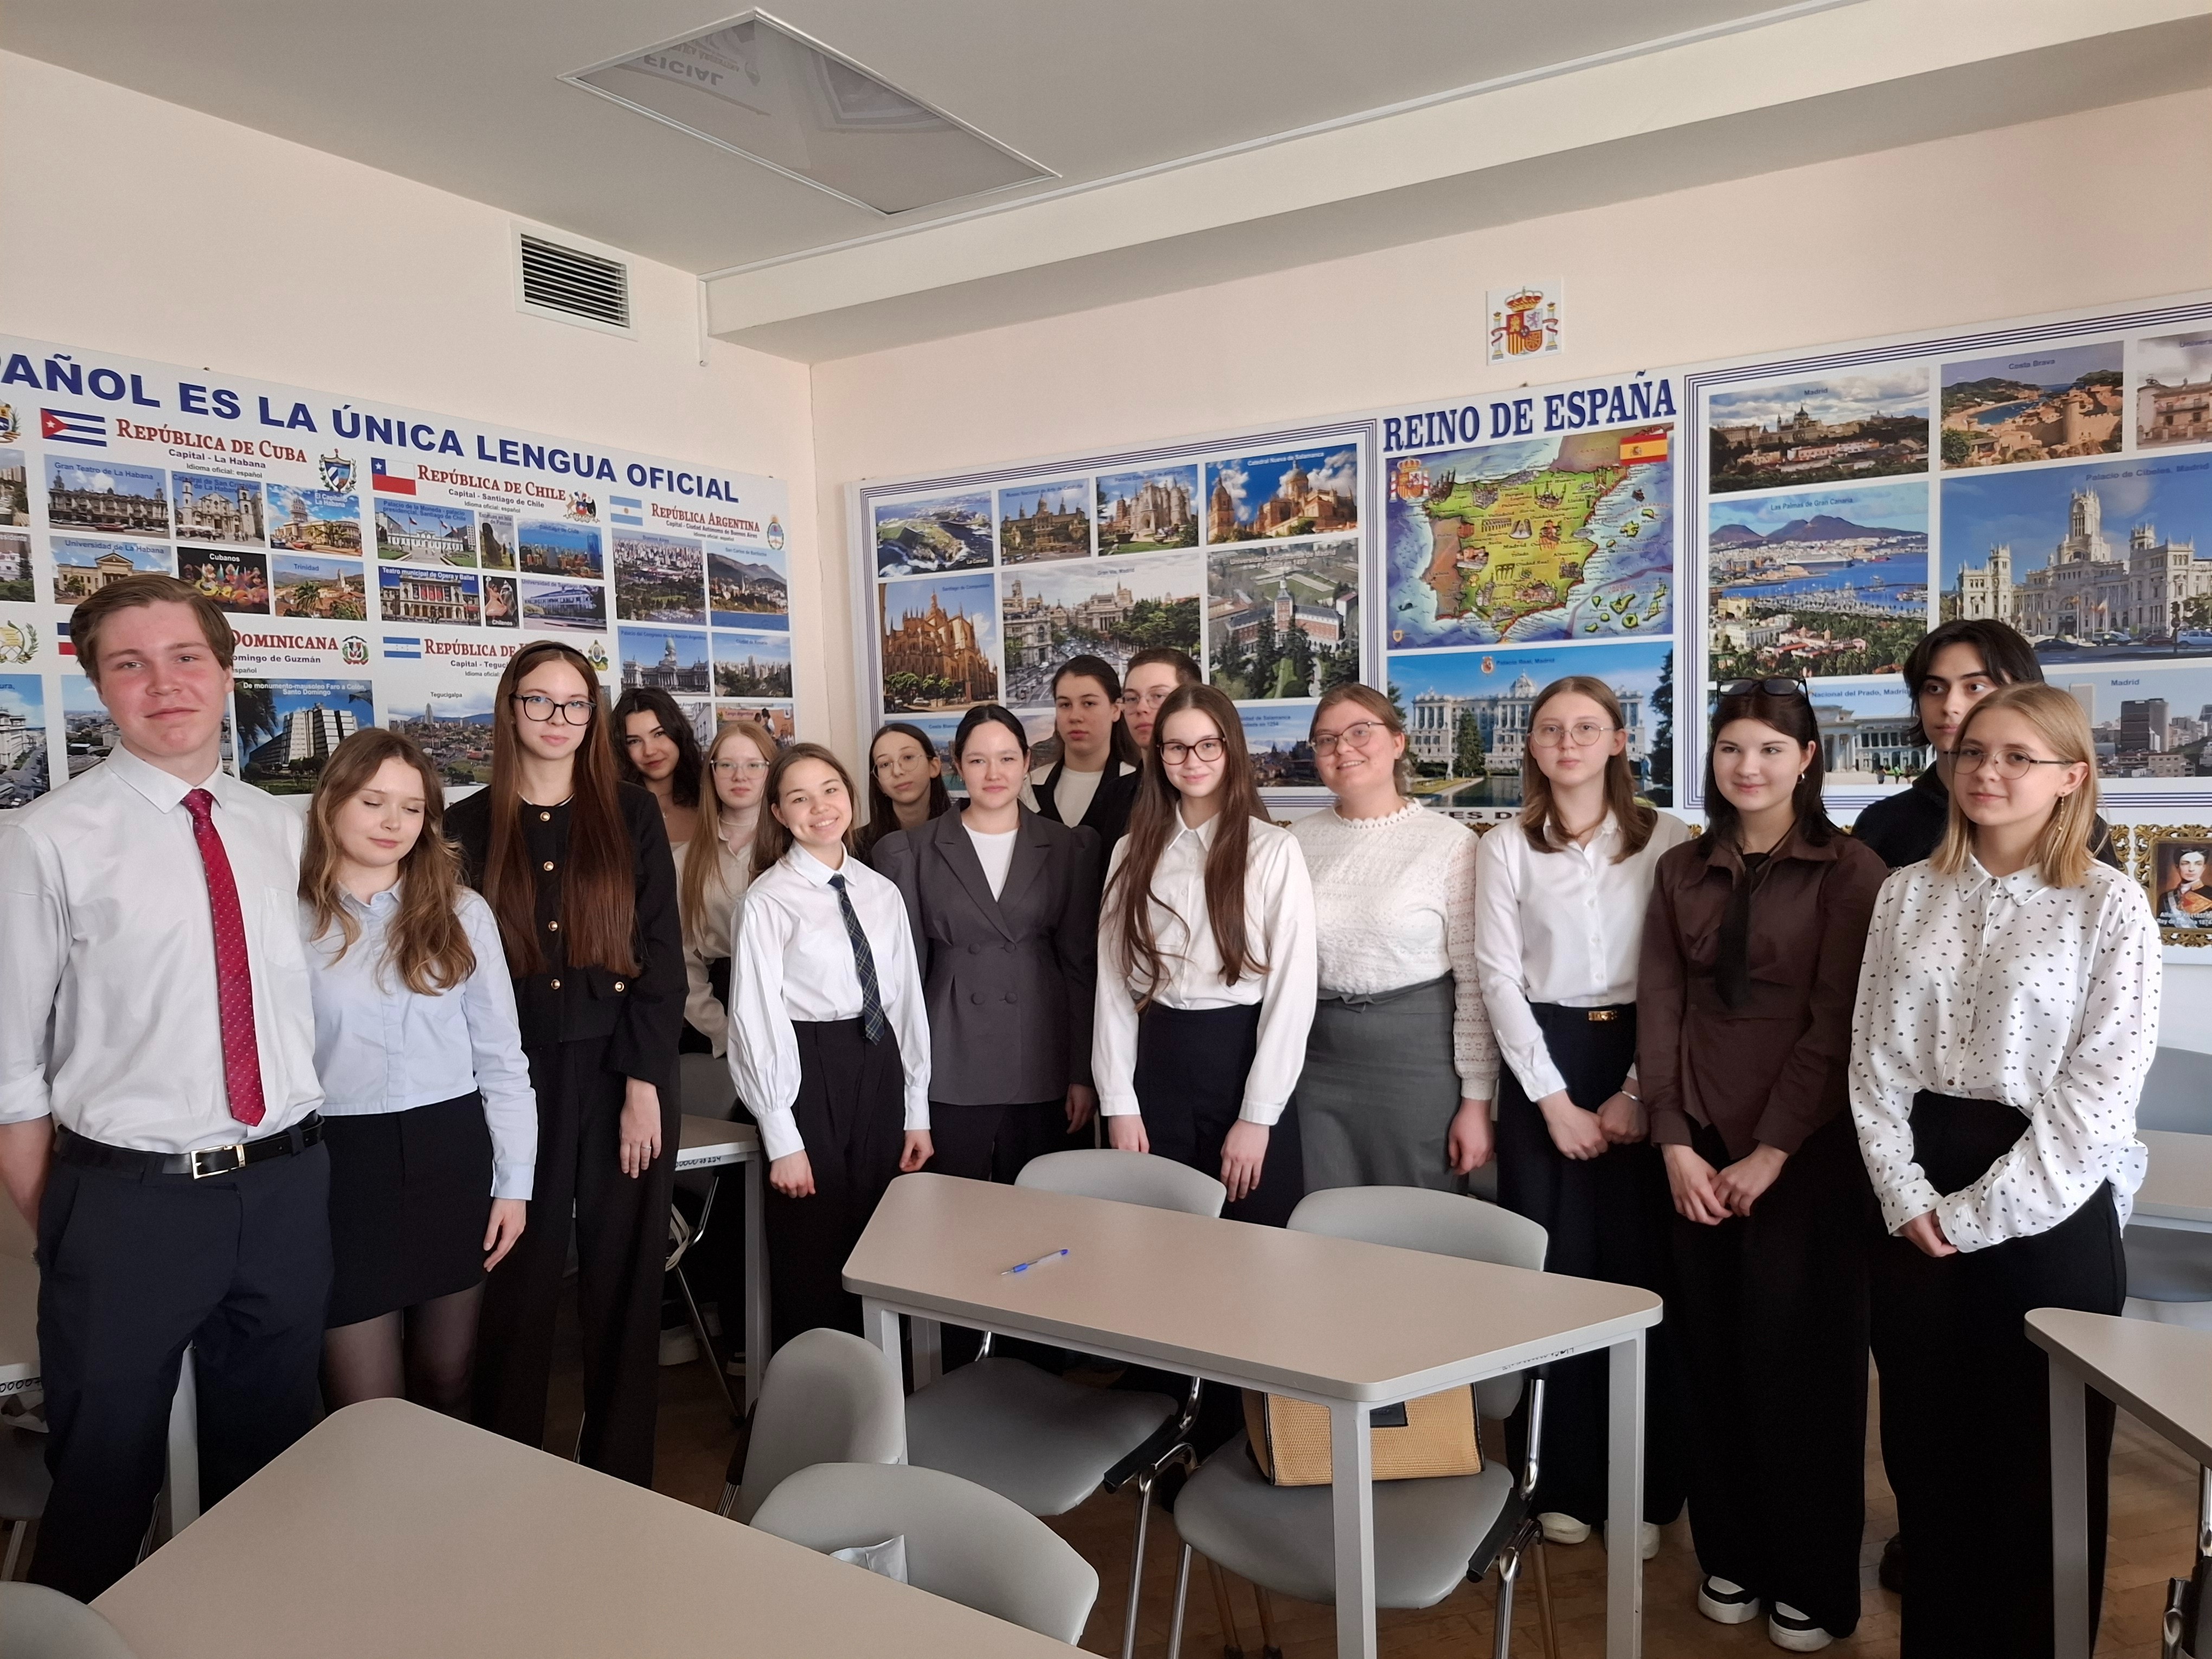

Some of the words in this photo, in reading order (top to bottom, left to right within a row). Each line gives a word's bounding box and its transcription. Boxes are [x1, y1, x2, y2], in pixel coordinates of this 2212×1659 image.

[2009, 361, 2031, 370] Costa
[2033, 358, 2055, 368] Brava
[1804, 387, 1828, 396] Madrid
[1383, 406, 1480, 453] REINO
[1490, 398, 1533, 439] DE
[1544, 369, 1676, 432] ESPAÑA
[0, 353, 161, 408] AÑOL
[179, 382, 241, 420] ES
[259, 395, 318, 433] LA
[332, 404, 464, 457] ÚNICA
[477, 435, 617, 483] LENGUA
[626, 463, 739, 503] OFICIAL
[169, 448, 205, 461] Capital
[214, 455, 226, 463] La
[229, 457, 266, 468] Habana
[259, 440, 307, 463] CUBA
[55, 462, 74, 472] Gran
[76, 464, 100, 474] Teatro
[102, 466, 112, 475] de
[114, 468, 123, 476] La
[125, 469, 153, 480] Habana
[187, 464, 210, 472] Idioma
[212, 466, 235, 475] oficial:
[236, 470, 263, 479] español
[2086, 472, 2119, 481] Palacio
[2176, 462, 2209, 473] Madrid
[525, 481, 566, 500] CHILE
[383, 500, 404, 509] Palacio
[448, 488, 476, 499] Capital
[482, 493, 515, 505] Santiago
[527, 499, 545, 509] Chile
[1783, 501, 1804, 510] Palmas
[1830, 497, 1853, 505] Canaria
[483, 503, 500, 511] oficial:
[708, 512, 761, 532] ARGENTINA
[65, 539, 112, 550] Universidad
[113, 543, 124, 551] de
[125, 544, 134, 552] La
[136, 545, 165, 554] Habana
[209, 552, 241, 563] Cubanos
[294, 563, 319, 571] Trinidad
[382, 567, 401, 575] Teatro
[402, 569, 429, 578] municipal
[438, 572, 454, 580] Opera
[232, 654, 267, 663] omingo
[285, 654, 321, 664] Guzmán
[451, 660, 477, 668] Capital
